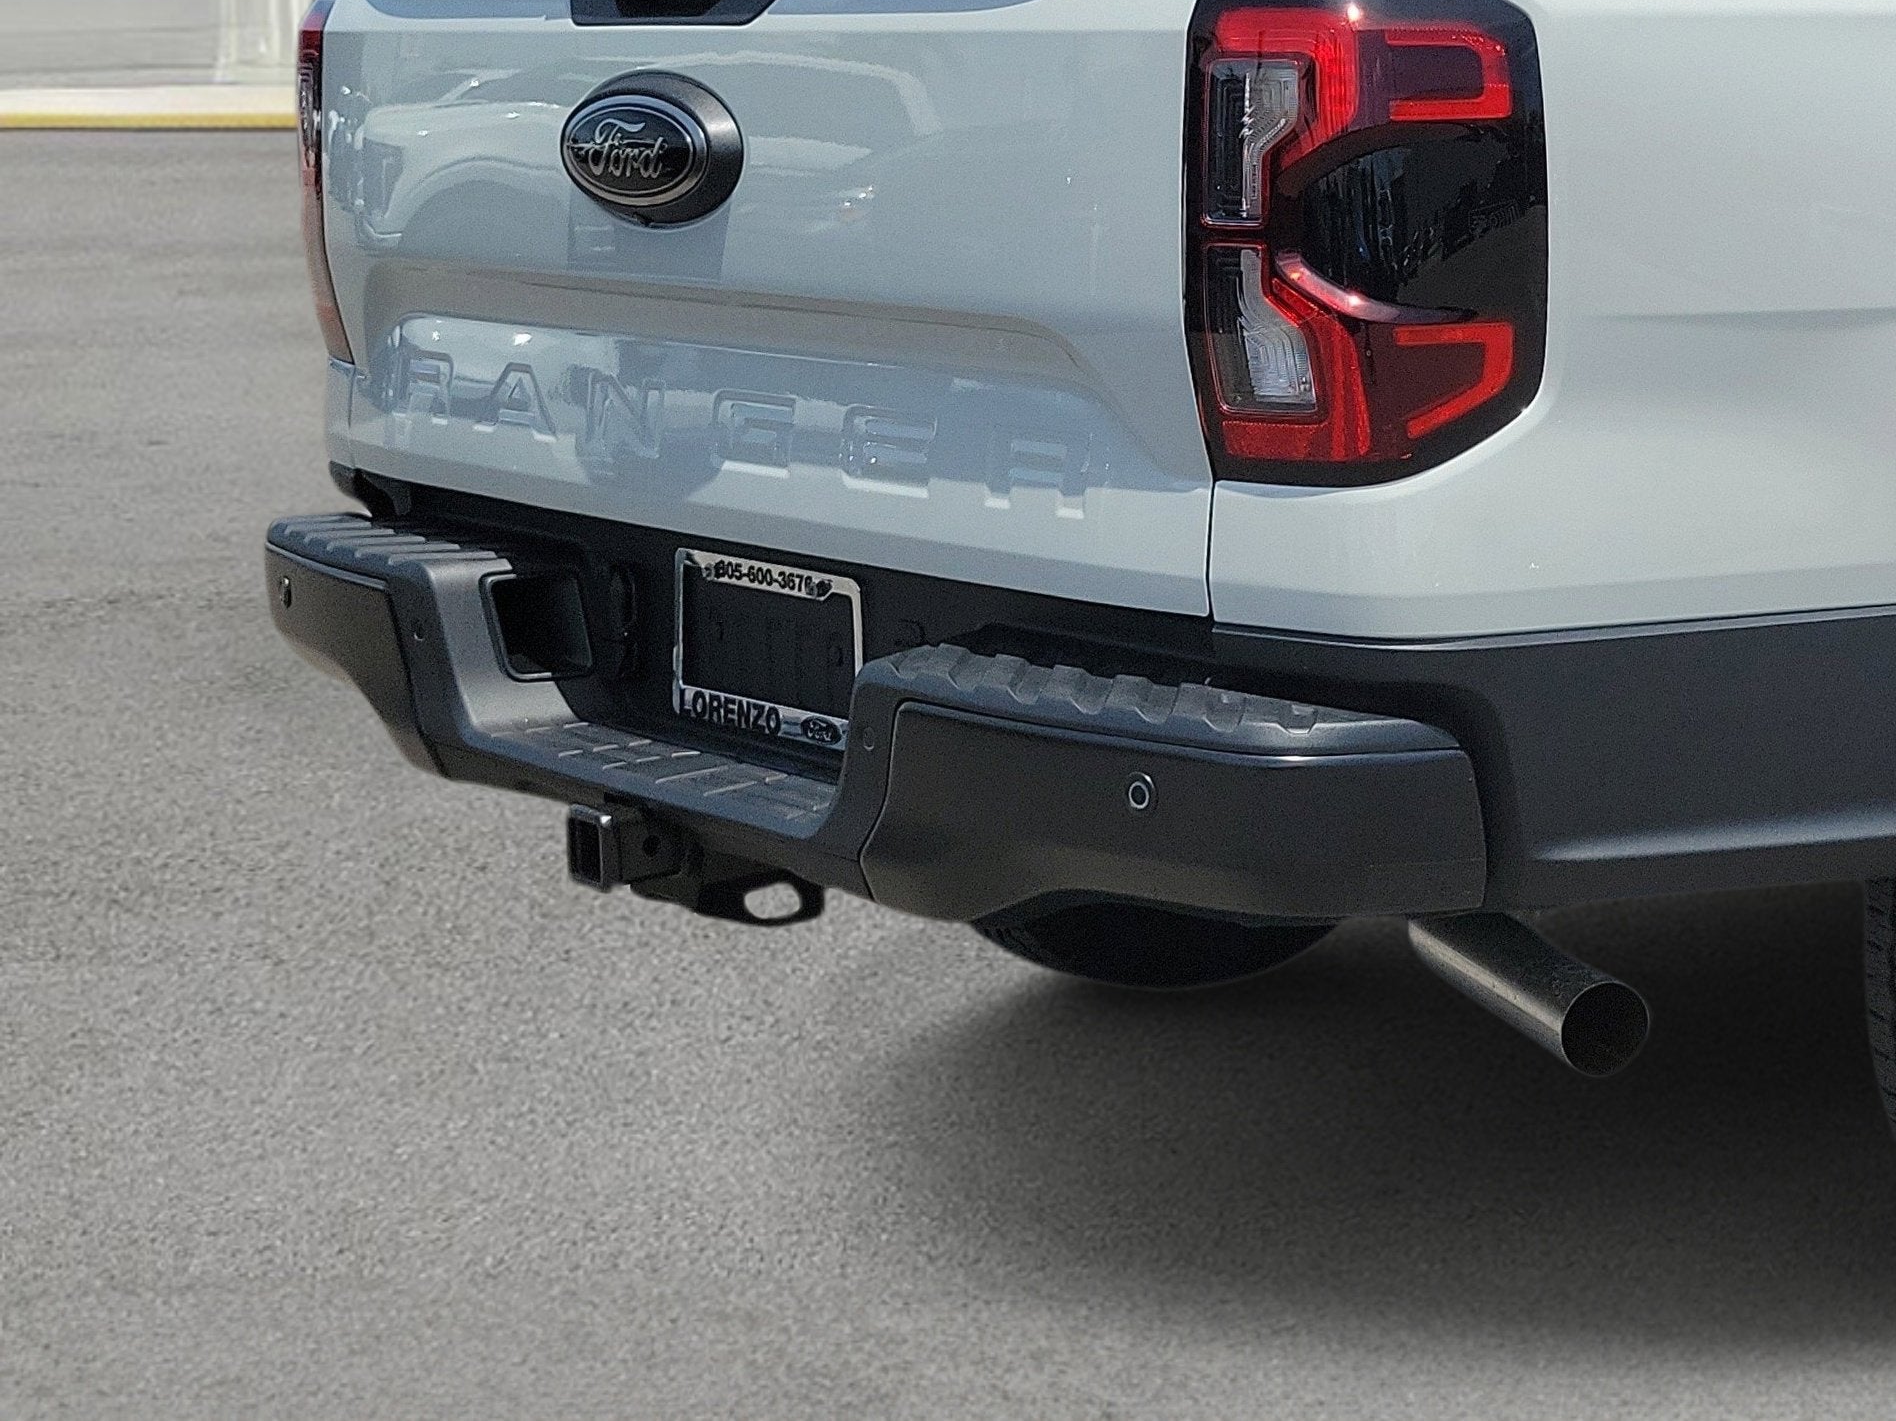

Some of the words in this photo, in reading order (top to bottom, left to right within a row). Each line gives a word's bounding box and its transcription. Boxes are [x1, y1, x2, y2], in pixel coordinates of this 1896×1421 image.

[587, 117, 670, 179] Ford
[391, 349, 1087, 521] RANGER
[679, 685, 782, 736] LORENZO
